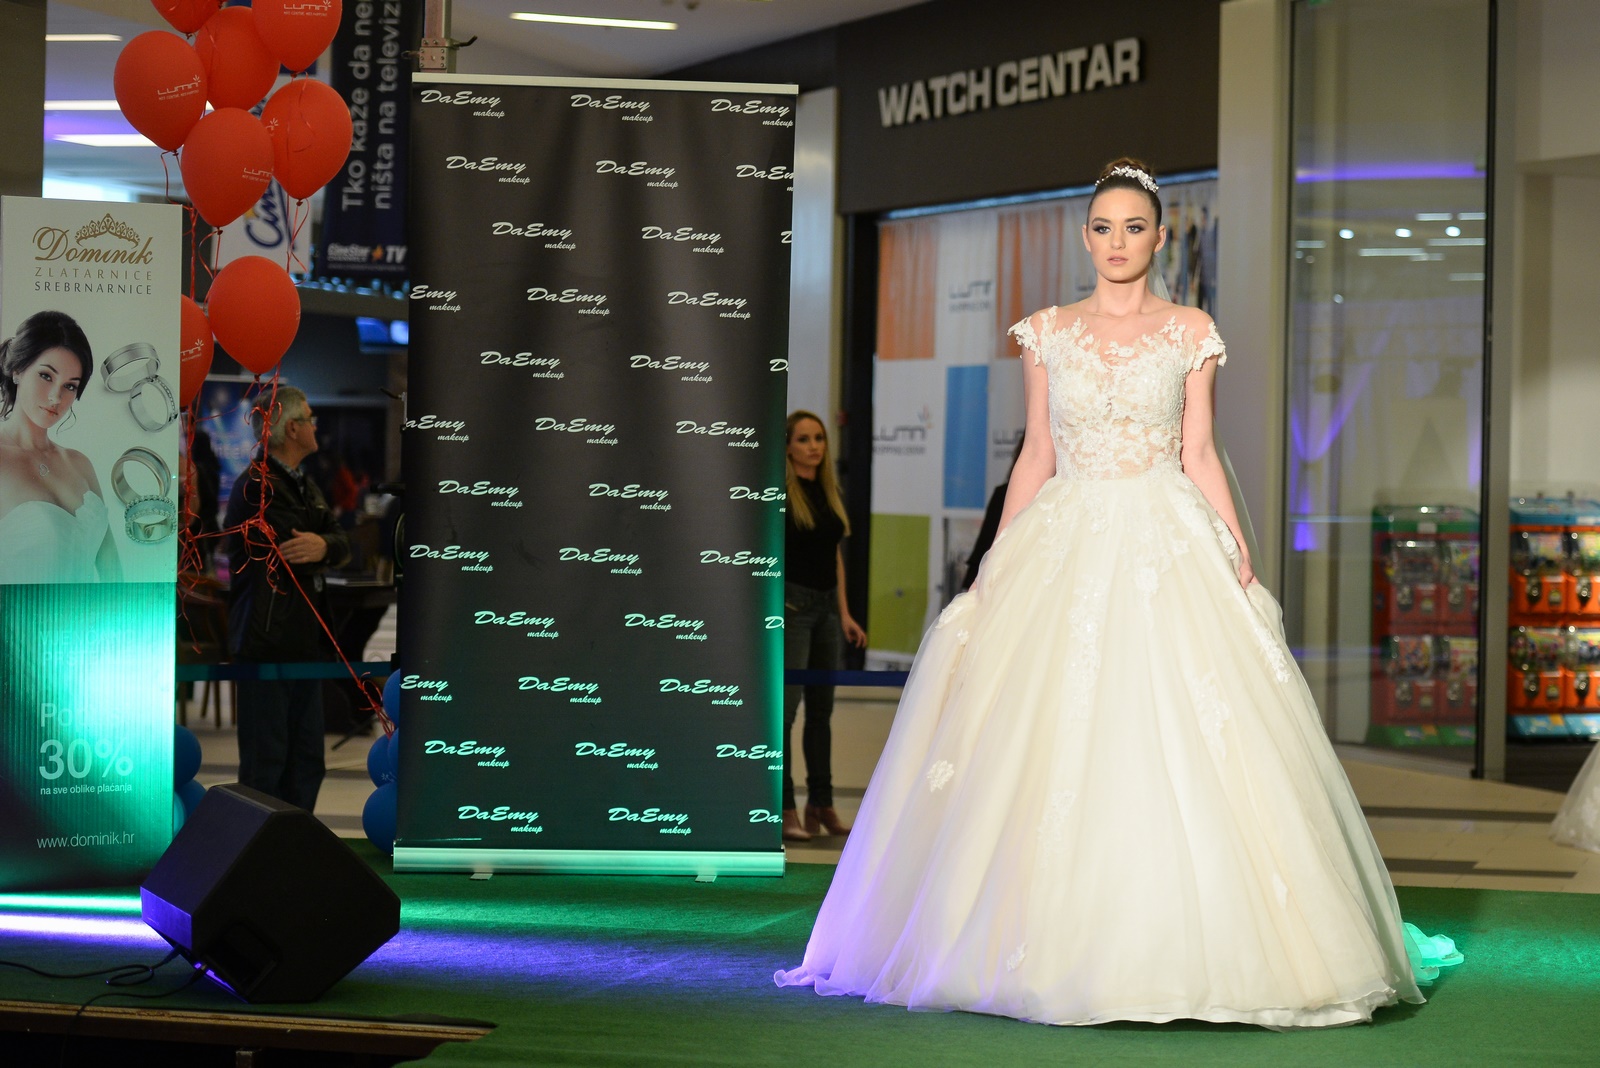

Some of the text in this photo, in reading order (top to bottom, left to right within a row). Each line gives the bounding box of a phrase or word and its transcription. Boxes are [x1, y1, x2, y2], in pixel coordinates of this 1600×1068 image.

[347, 44, 371, 80] da
[878, 37, 1140, 128] WATCH CENTAR
[421, 90, 501, 108] DaEmy
[571, 94, 650, 112] DaEmy
[473, 109, 505, 118] makeup
[711, 99, 789, 117] DaEmy
[378, 101, 397, 135] na
[622, 114, 653, 123] makeup
[763, 118, 792, 128] makeup
[446, 156, 526, 174] DaEmy
[596, 160, 675, 178] DaEmy
[342, 160, 366, 212] Tko
[499, 175, 530, 184] makeup
[647, 180, 678, 189] makeup
[492, 222, 572, 240] DaEmy
[642, 226, 721, 244] DaEmy
[33, 226, 153, 265] Dominik
[386, 244, 407, 263] TV
[545, 241, 576, 251] makeup
[693, 245, 724, 254] makeup
[35, 267, 152, 281] ZLATARNICE
[35, 281, 152, 295] SREBRNARNICE
[410, 285, 457, 302] Emy
[527, 288, 607, 305] DaEmy
[429, 303, 461, 312] makeup
[668, 291, 747, 309] DaEmy
[578, 307, 610, 316] makeup
[720, 310, 750, 320] makeup
[480, 351, 560, 369] DaEmy
[630, 355, 709, 372] DaEmy
[533, 370, 564, 380] makeup
[681, 374, 712, 383] makeup
[405, 415, 466, 432] aEmy
[535, 418, 615, 435] DaEmy
[676, 421, 755, 438] DaEmy
[437, 433, 470, 443] makeup
[587, 436, 618, 446] makeup
[728, 440, 759, 449] makeup
[438, 480, 519, 498] DaEmy
[589, 483, 668, 501] DaEmy
[491, 499, 522, 509] makeup
[640, 502, 671, 512] makeup
[410, 545, 489, 562] Emy
[559, 548, 639, 565] DaEmy
[700, 550, 778, 568] DaEmy
[462, 564, 493, 573] makeup
[611, 566, 642, 576] makeup
[752, 569, 782, 579] makeup
[475, 611, 555, 628] DaEmy
[625, 614, 704, 631] DaEmy
[527, 630, 559, 639] makeup
[676, 632, 707, 641] makeup
[399, 675, 448, 692] Emy
[518, 677, 599, 694] DaEmy
[660, 679, 739, 696] DaEmy
[420, 693, 452, 702] makeup
[570, 695, 601, 705] makeup
[712, 697, 743, 707] makeup
[425, 741, 505, 758] DaEmy
[575, 743, 655, 759] DaEmy
[716, 744, 783, 759] DaEm
[38, 738, 134, 780] 30%
[478, 759, 509, 768] makeup
[627, 761, 658, 770] makeup
[40, 782, 132, 795] na sve oblike plaćanja
[458, 806, 538, 823] DaEmy
[608, 808, 688, 825] DaEmy
[511, 824, 542, 834] makeup
[660, 826, 692, 836] makeup
[36, 831, 135, 849] www.dominik.hr
